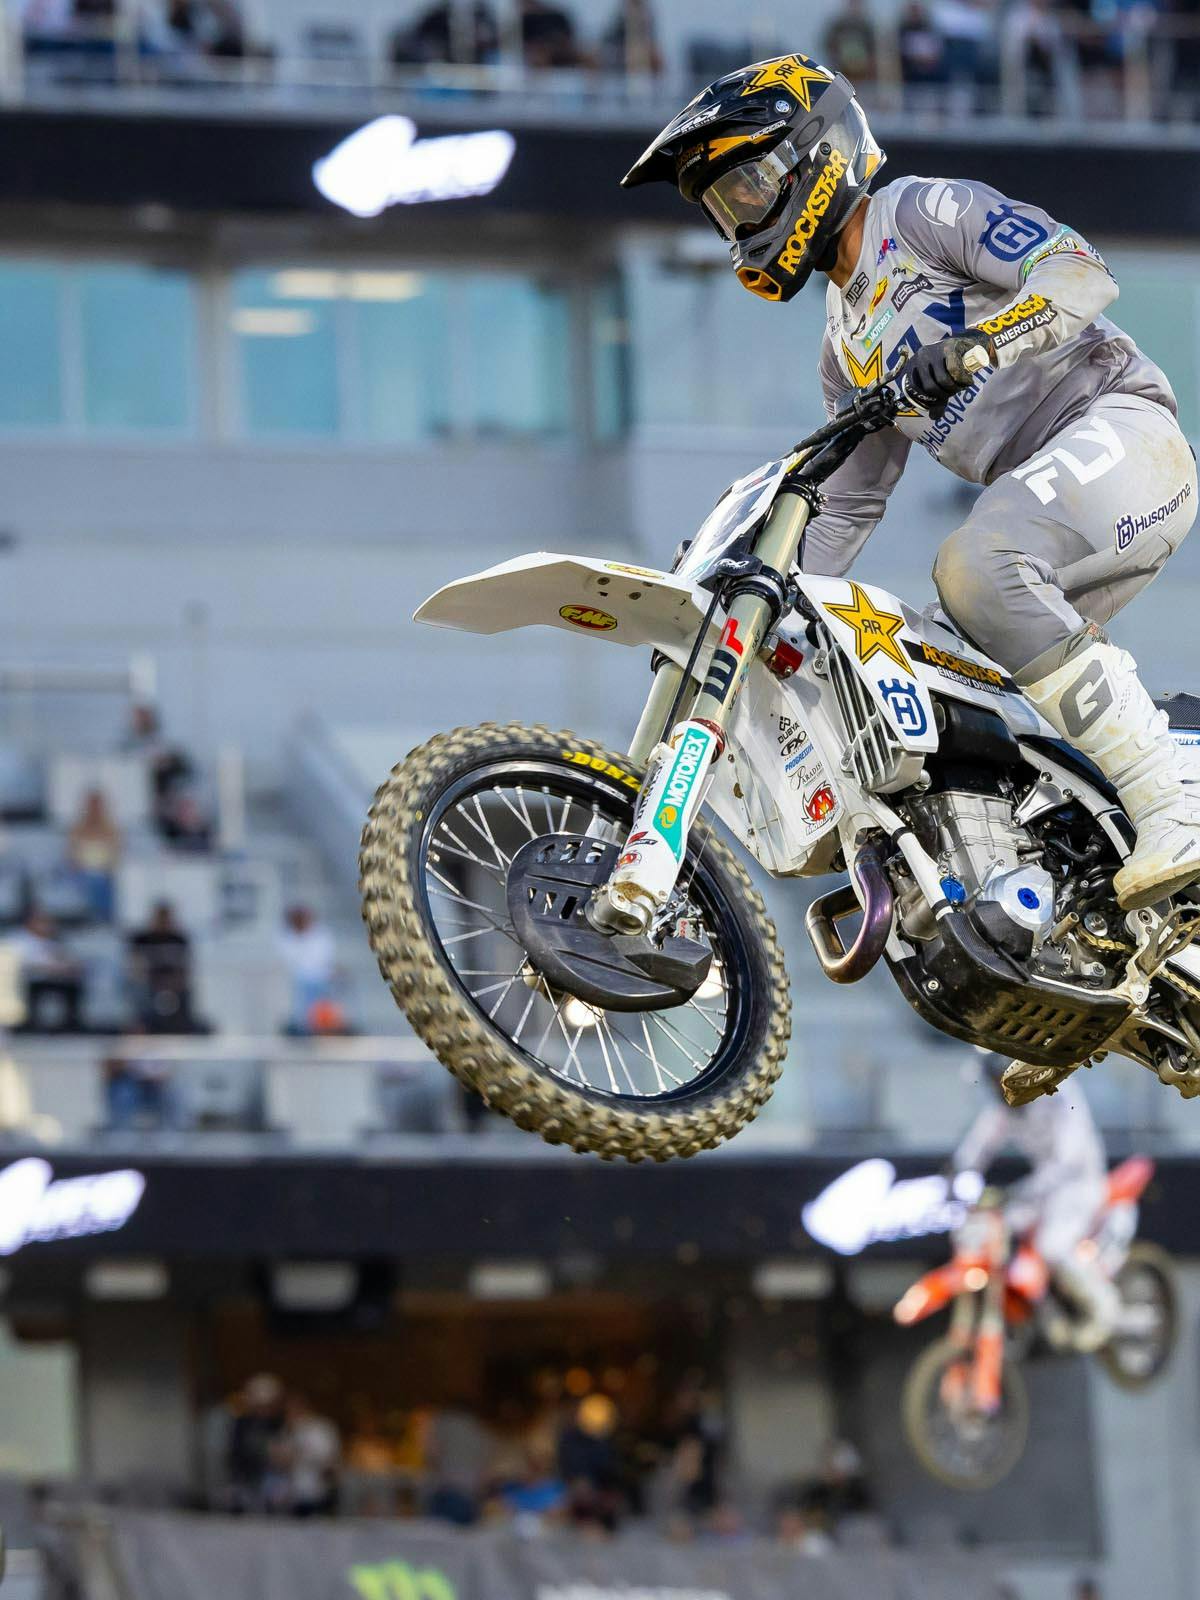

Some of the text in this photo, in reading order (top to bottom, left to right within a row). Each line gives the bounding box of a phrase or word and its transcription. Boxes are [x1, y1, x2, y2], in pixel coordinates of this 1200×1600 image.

[778, 149, 848, 275] ROCKSTAR
[845, 271, 869, 307] WPS
[868, 310, 894, 341] MOTOREX
[993, 318, 1034, 347] ENERGY
[1011, 416, 1126, 505] FLY
[1134, 481, 1191, 535] Husqvarna
[561, 608, 618, 629] FMF
[920, 641, 1006, 687] ROCKSTAR
[936, 666, 1008, 698] ENERGY DRINK
[1060, 659, 1114, 738] G
[777, 721, 800, 744] DUBYA
[664, 735, 707, 808] MOTOREX
